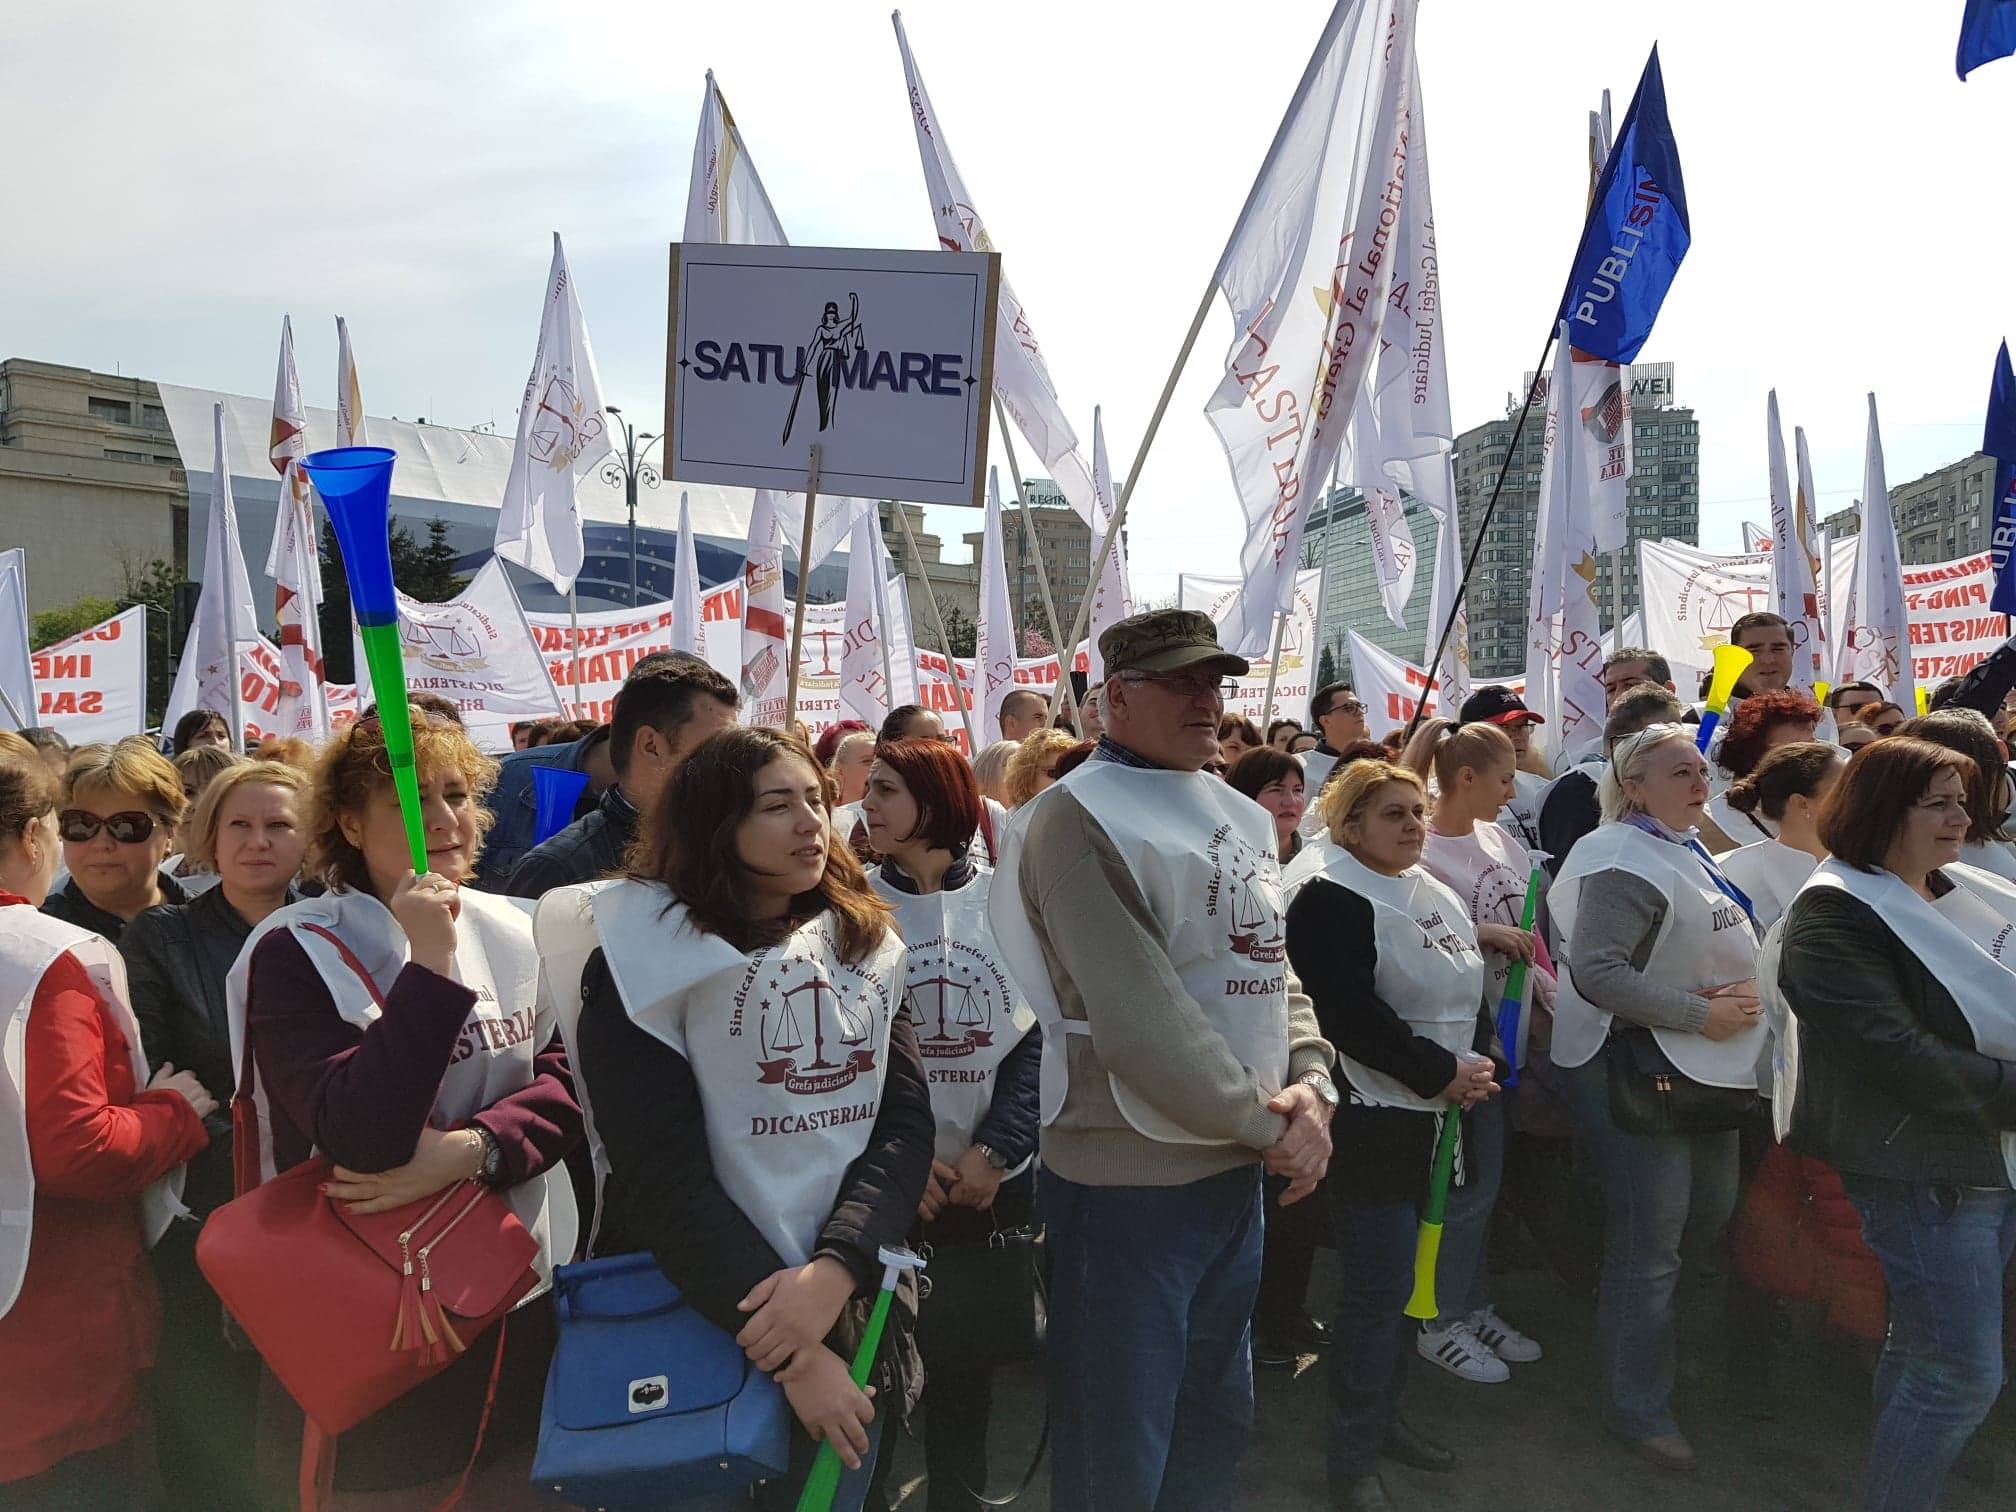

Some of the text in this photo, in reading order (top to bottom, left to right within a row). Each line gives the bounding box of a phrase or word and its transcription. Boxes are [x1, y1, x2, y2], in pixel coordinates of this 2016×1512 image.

[692, 340, 963, 396] SATU MARE
[846, 964, 889, 1022] Judiciare
[907, 934, 942, 955] țional
[951, 940, 988, 962] Grefei
[985, 961, 1011, 1014] Judiciare
[788, 1079, 813, 1091] Grefa
[928, 1069, 993, 1084] STERIA
[751, 1100, 877, 1136] DICASTERIAL
